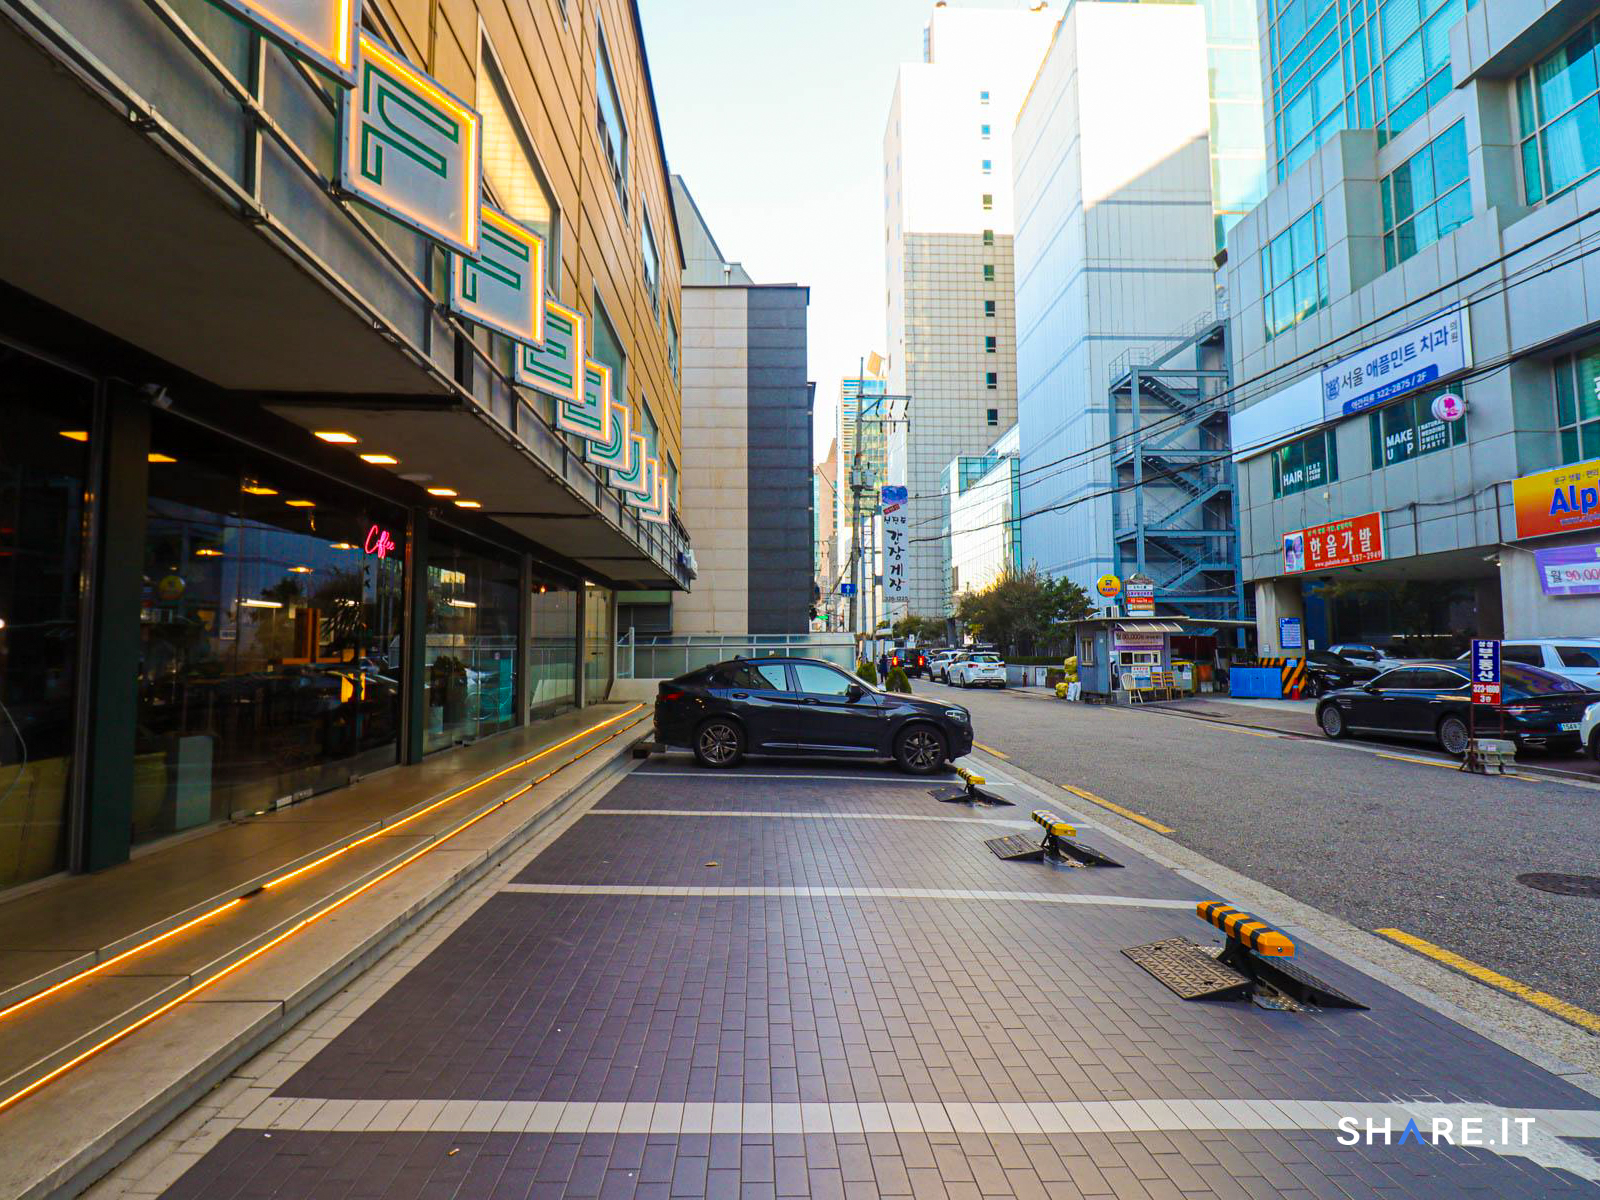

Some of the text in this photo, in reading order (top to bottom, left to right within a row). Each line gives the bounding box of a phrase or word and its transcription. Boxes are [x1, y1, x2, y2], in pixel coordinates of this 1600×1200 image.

[1341, 366, 1364, 390] 서울
[1366, 342, 1418, 379] 애플민트
[1420, 325, 1449, 353] 치과
[1386, 428, 1414, 447] MAKE
[1421, 438, 1446, 450] PARTY
[1283, 469, 1303, 487] HAIR
[886, 529, 906, 592] 간장게장
[1477, 647, 1495, 682] 부동산
